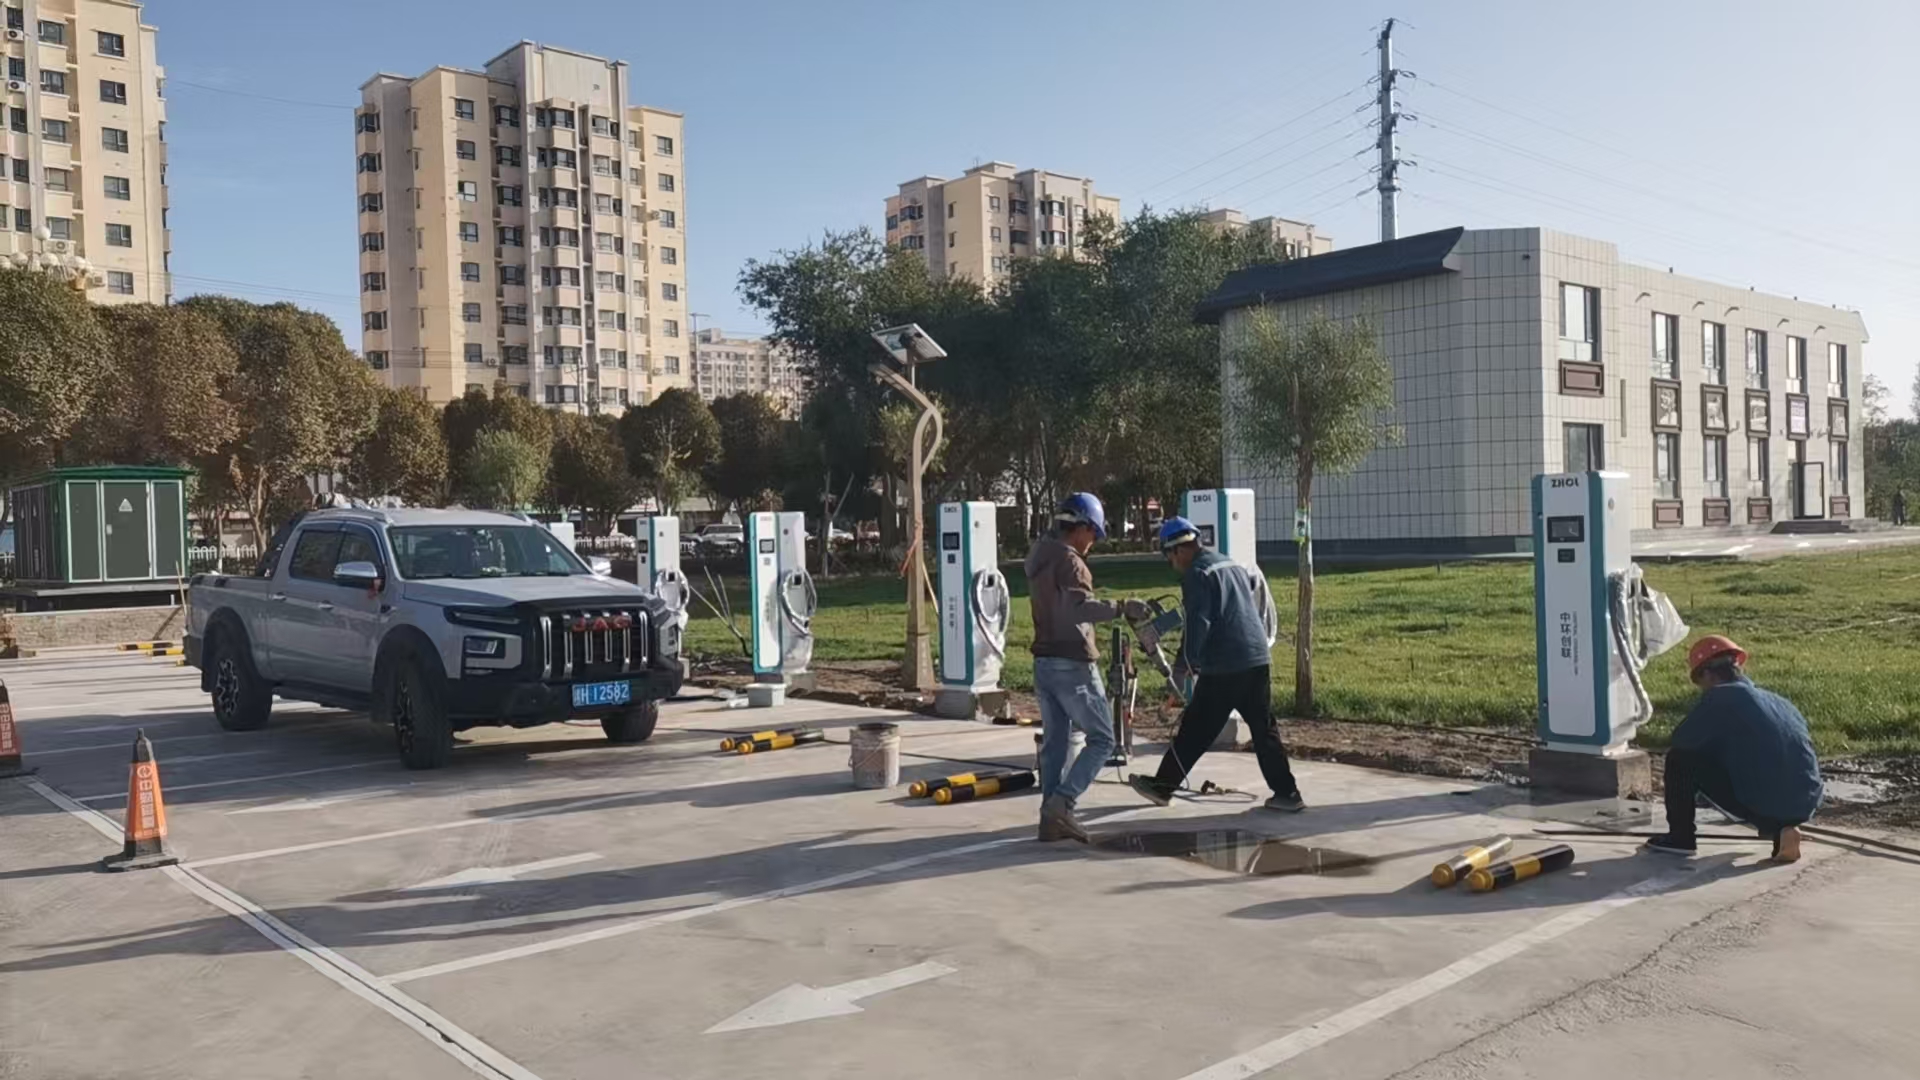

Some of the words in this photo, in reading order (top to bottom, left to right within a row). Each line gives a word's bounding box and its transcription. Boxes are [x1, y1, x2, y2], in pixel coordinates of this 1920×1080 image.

[1560, 611, 1571, 658] 中环创联
[574, 683, 629, 704] H12582
